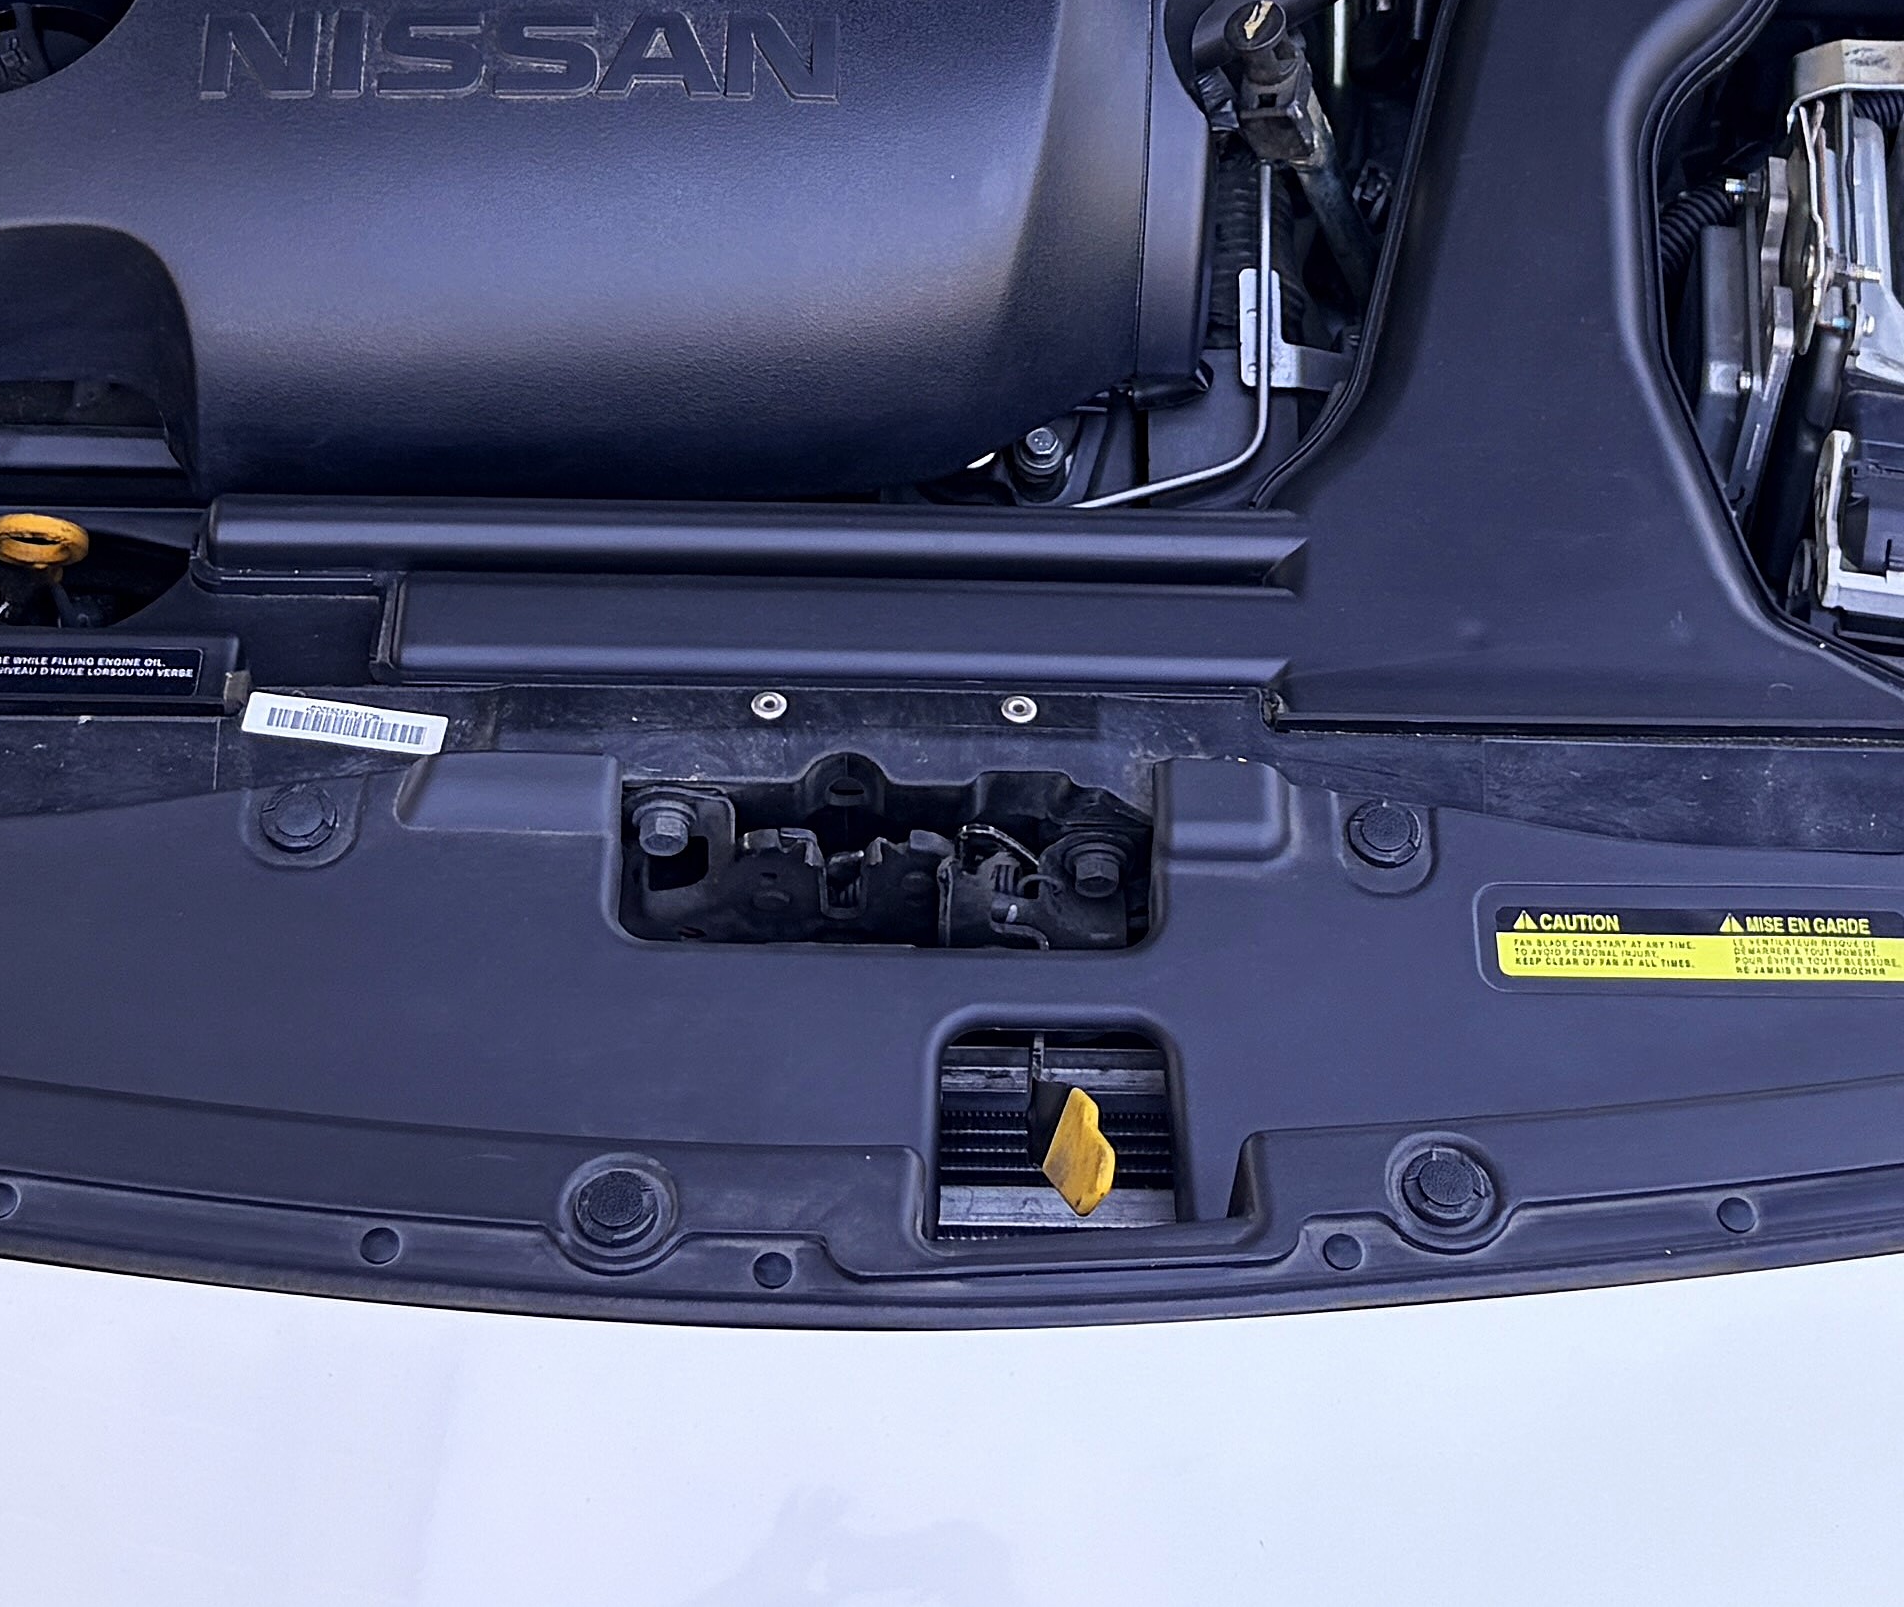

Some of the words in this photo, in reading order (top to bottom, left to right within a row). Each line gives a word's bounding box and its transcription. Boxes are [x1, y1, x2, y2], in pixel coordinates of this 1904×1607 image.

[199, 10, 840, 104] NISSAN
[13, 656, 48, 665] WHILE
[51, 656, 95, 666] FILLING
[97, 657, 141, 667] ENGINE
[143, 658, 166, 667] OIL.
[1539, 913, 1620, 932] CAUTION
[1746, 916, 1785, 933] MISE
[1788, 917, 1811, 933] EN
[1813, 917, 1872, 935] GARDE
[1514, 939, 1533, 947] FAN
[1536, 939, 1567, 948] BLADE
[1572, 940, 1593, 948] CAN
[1596, 940, 1626, 948] START
[1631, 940, 1643, 948] AT
[1646, 941, 1665, 949] ANY
[1670, 941, 1696, 950] TIME.
[1749, 939, 1818, 947] VENTILATEUR
[1821, 940, 1859, 948] RISQUE
[1863, 940, 1876, 948] DE
[1515, 948, 1528, 956] TO
[1531, 948, 1561, 957] AVOID
[1565, 949, 1618, 957] PERSONAL
[1805, 948, 1830, 956] TOUT
[1835, 948, 1880, 958] MOMENT.
[1515, 957, 1542, 966] KEEP
[1546, 957, 1579, 966] CLEAR
[1583, 958, 1596, 966] OF
[1599, 958, 1619, 967] FAN
[1623, 958, 1634, 967] AT
[1639, 959, 1657, 967] ALL
[1661, 959, 1696, 968] TIMES.
[1735, 956, 1763, 965] POUR
[1808, 957, 1839, 966] TOUTE
[1736, 966, 1750, 974] NE
[1754, 966, 1792, 975] JAMAIS
[1823, 967, 1886, 976] APPROCHER
